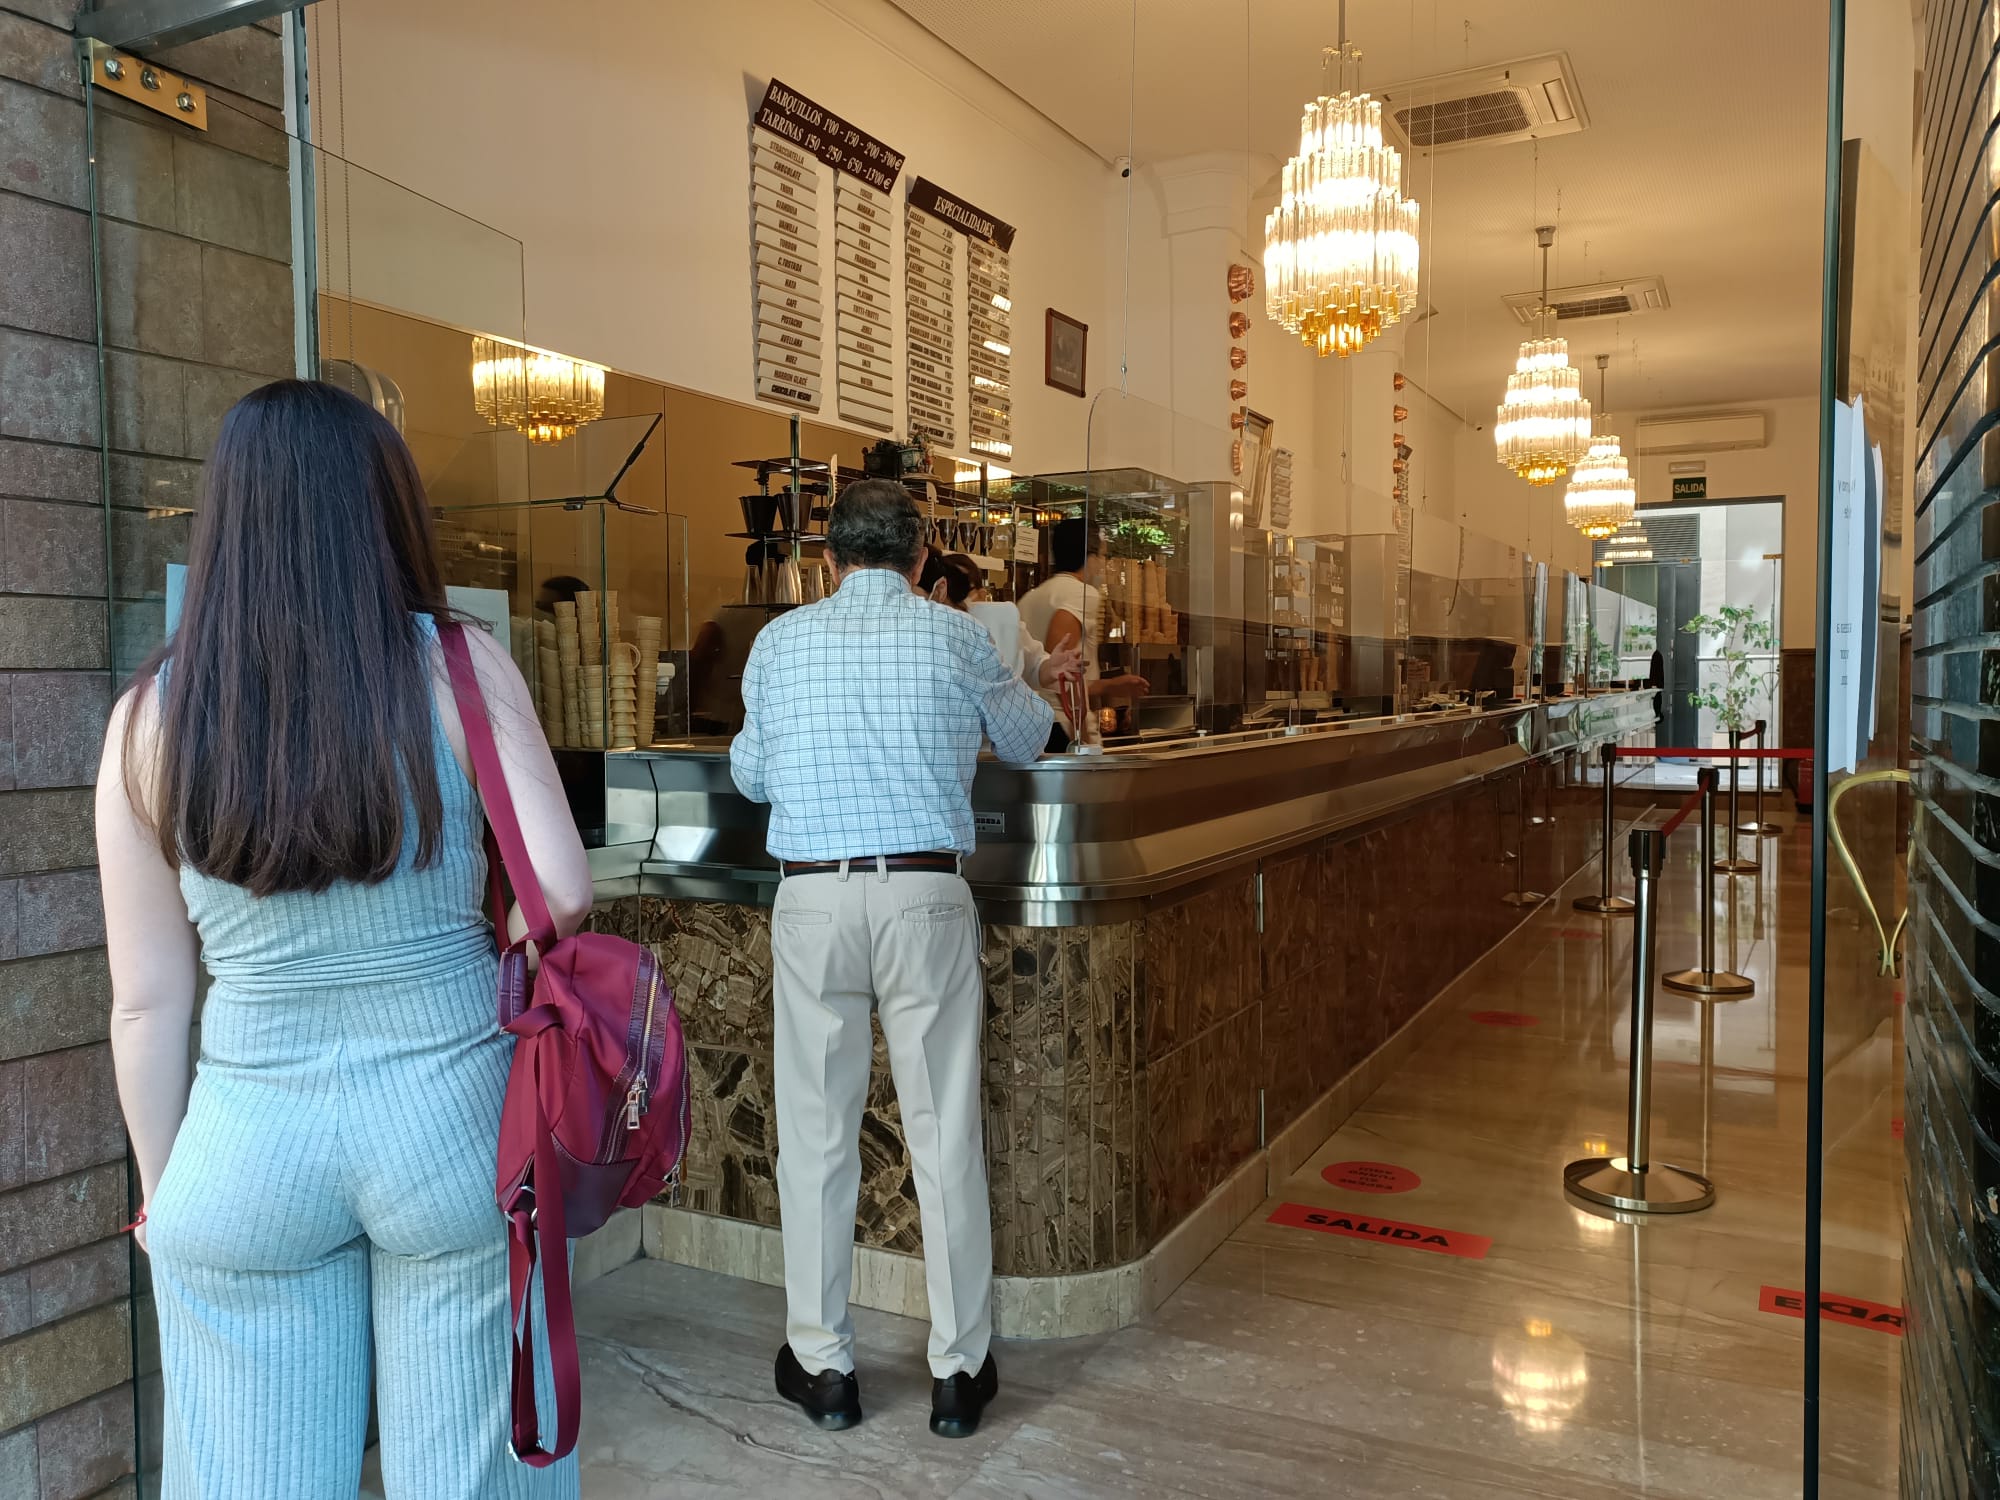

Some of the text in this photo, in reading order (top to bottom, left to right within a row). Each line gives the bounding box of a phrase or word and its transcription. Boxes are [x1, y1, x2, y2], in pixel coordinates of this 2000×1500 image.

[769, 86, 822, 126] BARQUILLOS
[761, 108, 804, 142] TARRINAS
[774, 161, 802, 181] CHOCOLATE
[933, 195, 995, 237] ESPECIALIDADES
[780, 314, 803, 328] PISTACHO
[780, 334, 803, 348] AVELLANA
[1675, 482, 1705, 494] SALIDA
[1304, 1213, 1449, 1247] SALIDA
